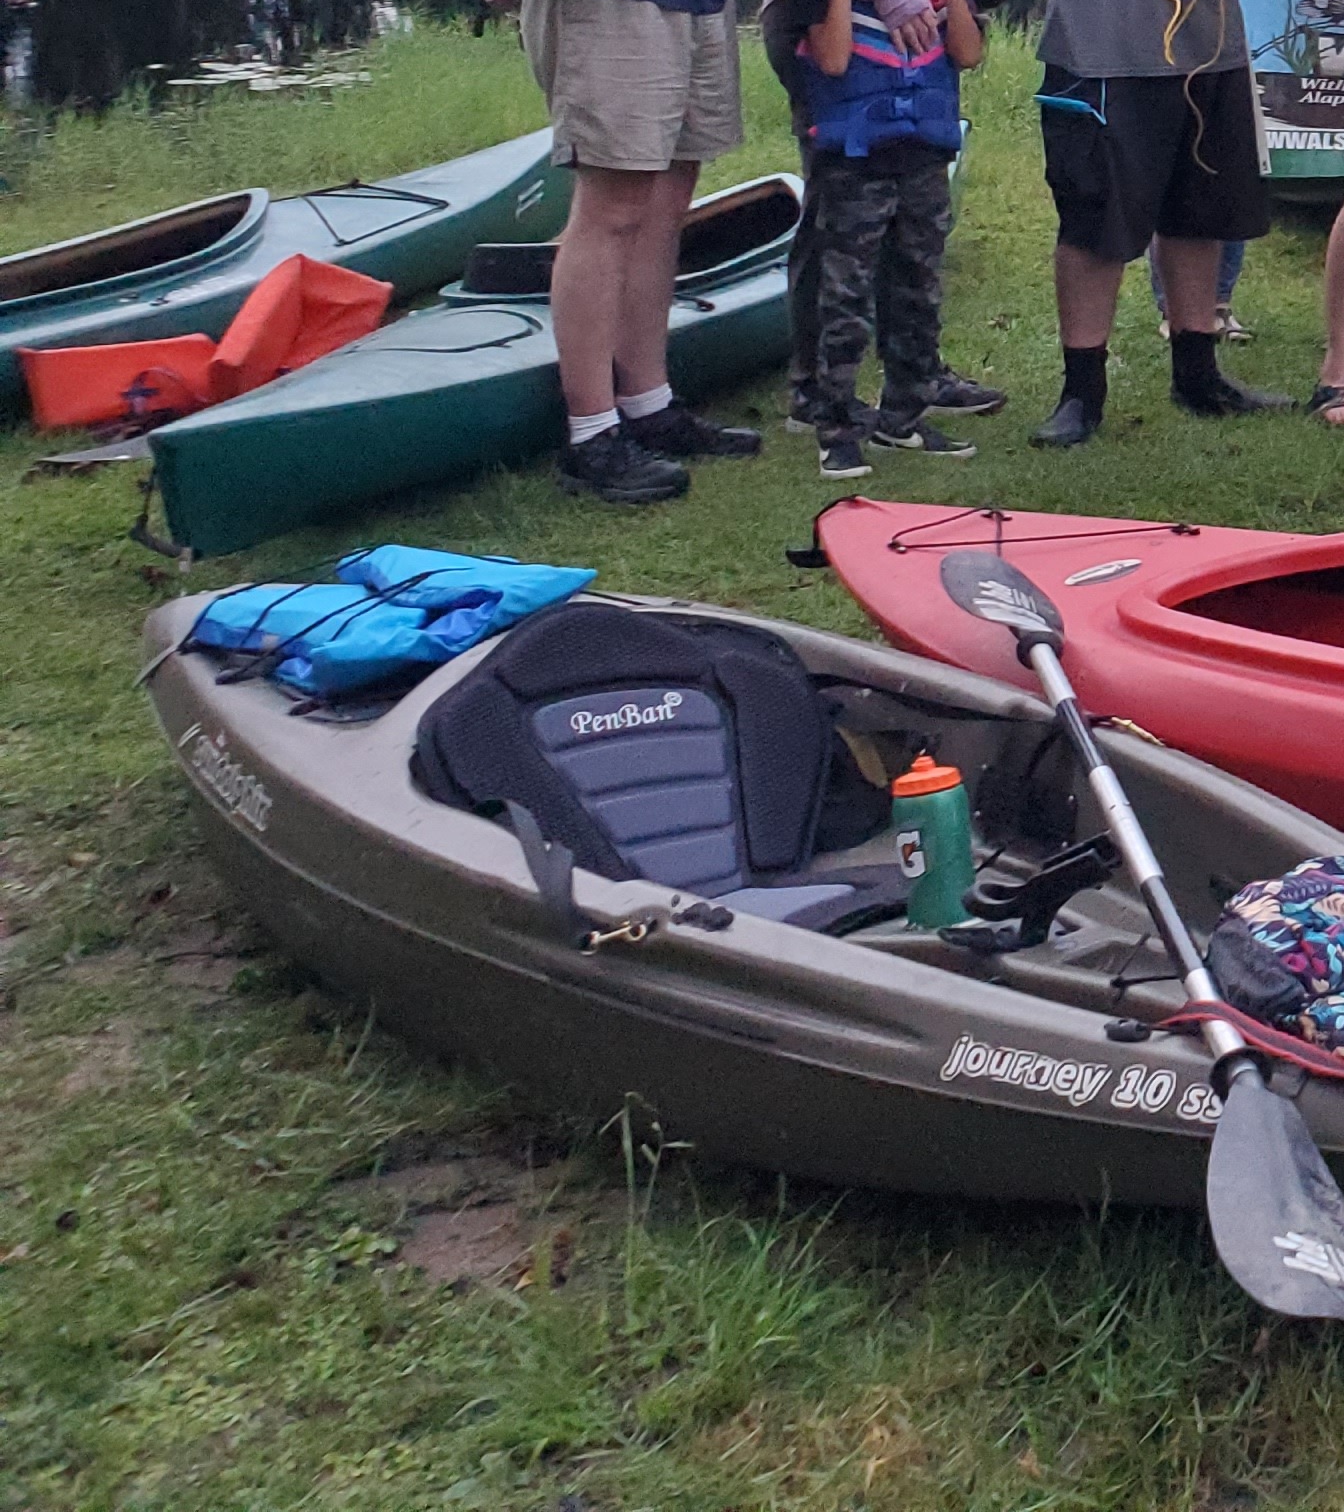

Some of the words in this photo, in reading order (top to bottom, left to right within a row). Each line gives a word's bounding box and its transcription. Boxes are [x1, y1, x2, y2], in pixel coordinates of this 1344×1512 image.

[897, 830, 926, 879] G
[941, 1032, 1111, 1106] journey
[1111, 1064, 1176, 1113] 10
